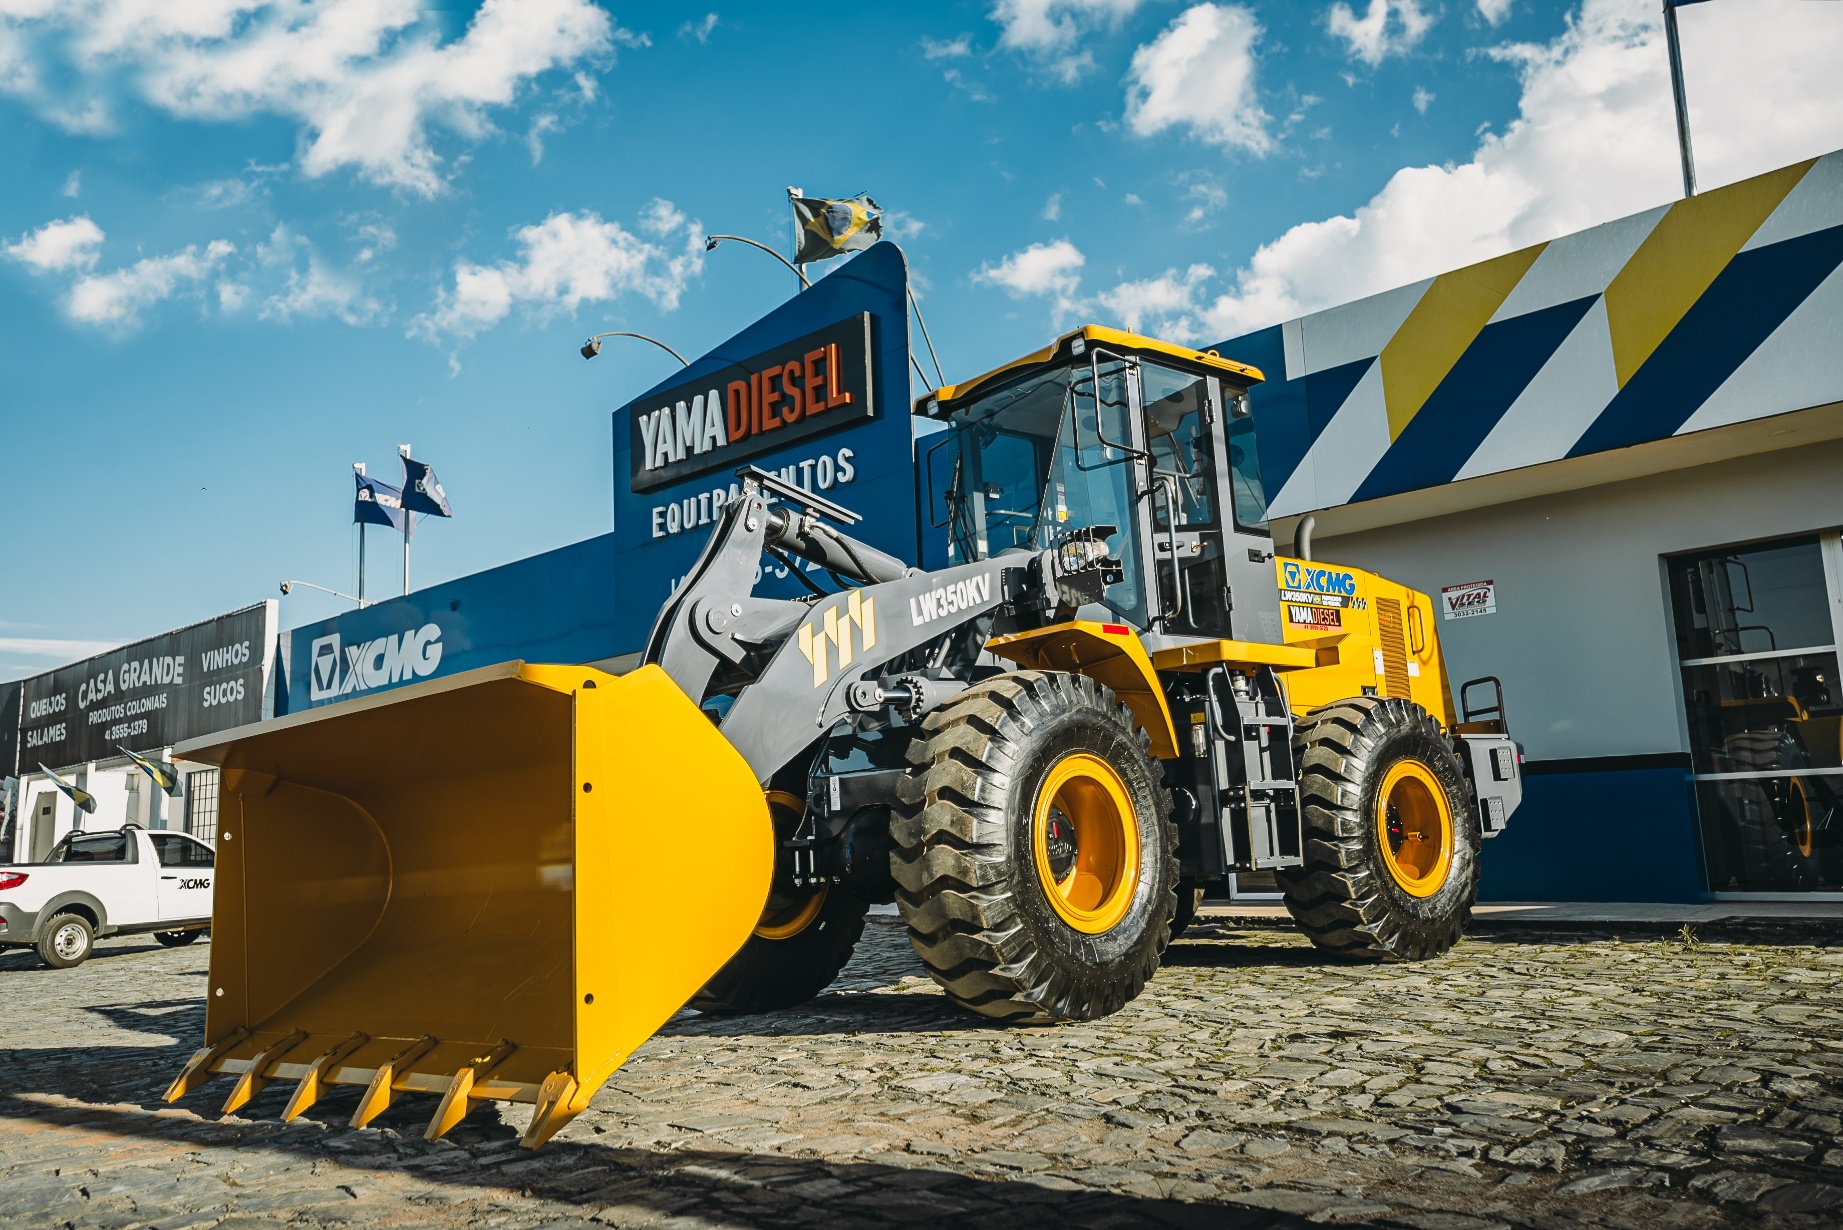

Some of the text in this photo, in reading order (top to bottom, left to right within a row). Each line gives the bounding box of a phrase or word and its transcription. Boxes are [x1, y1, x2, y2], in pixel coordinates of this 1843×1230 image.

[638, 343, 854, 471] YAMADIESEL
[652, 448, 854, 538] EQUIPAENTOS
[1303, 568, 1356, 596] XCMG
[909, 572, 991, 627] LW350KV
[1448, 591, 1489, 611] VITAL
[1290, 606, 1339, 626] YAMADIESEL
[202, 641, 250, 672] VINHOS
[339, 623, 443, 695] XCMG
[78, 656, 184, 710] CASA GRANDE
[203, 679, 245, 708] SUCOS
[30, 693, 67, 719] QUEIJOS
[88, 693, 168, 725] PRODUTOS COLONIAIS
[26, 722, 67, 749] SALAMES
[111, 719, 148, 740] 3555-1379
[178, 878, 210, 890] XCMG
